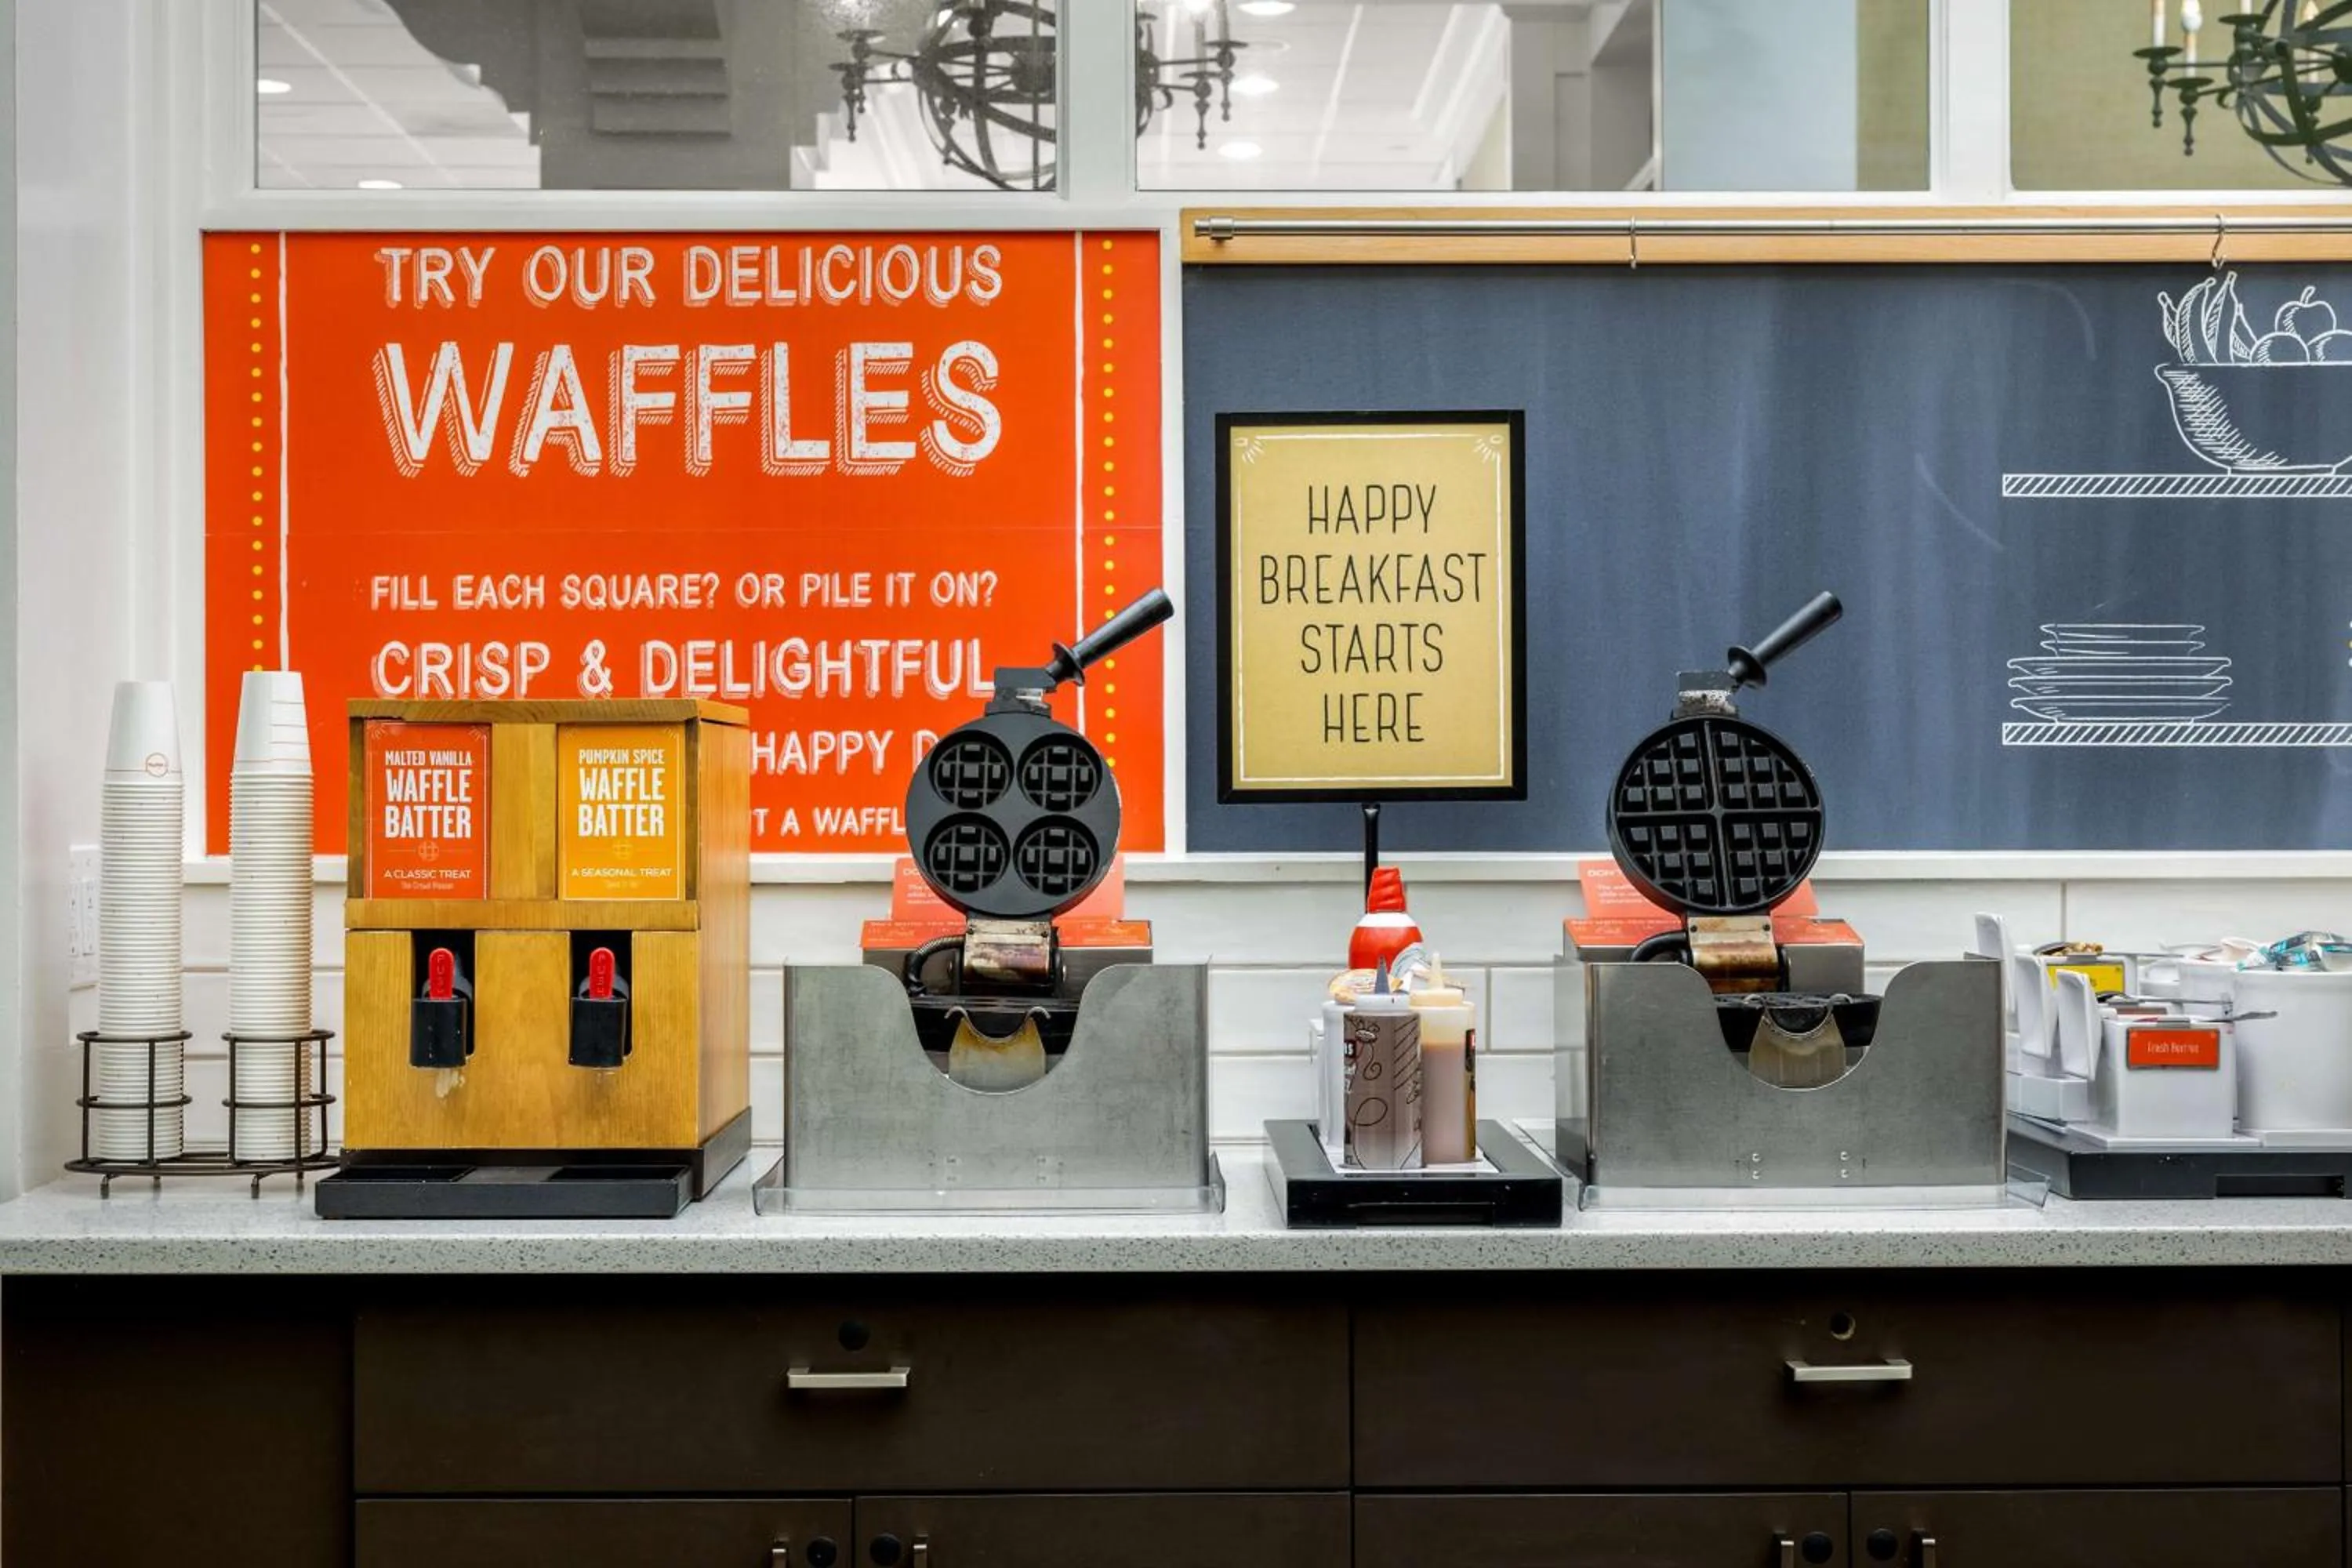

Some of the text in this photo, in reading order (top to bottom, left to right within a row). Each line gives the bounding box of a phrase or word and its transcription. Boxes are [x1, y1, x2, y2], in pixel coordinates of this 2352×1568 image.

[375, 244, 1003, 309] TRY OUR DELICIOUS
[372, 340, 1002, 477] WAFFLES
[1308, 484, 1436, 534] HAPPY
[371, 570, 998, 610] FILL EACH SQUARE? OR PILE IT ON?
[1260, 553, 1486, 604] BREAKFAST
[1301, 622, 1443, 673] STARTS
[371, 637, 994, 699] CRISP & DELIGHTFUL
[1324, 692, 1425, 743] HERE
[385, 750, 473, 766] MALTED VANILLA
[579, 749, 665, 765] PUMPKIN SPICE
[750, 730, 894, 775] HAPPY
[385, 768, 473, 803] WAFFLE
[579, 767, 666, 801] WAFFLE
[384, 804, 472, 839] BATTER
[578, 803, 665, 837] BATTER
[780, 808, 800, 837] A
[812, 806, 906, 837] WAFFL
[394, 869, 436, 879] CLASSIC
[439, 869, 471, 879] TREAT
[581, 868, 637, 877] SEASONAL
[640, 868, 672, 877] TREAT
